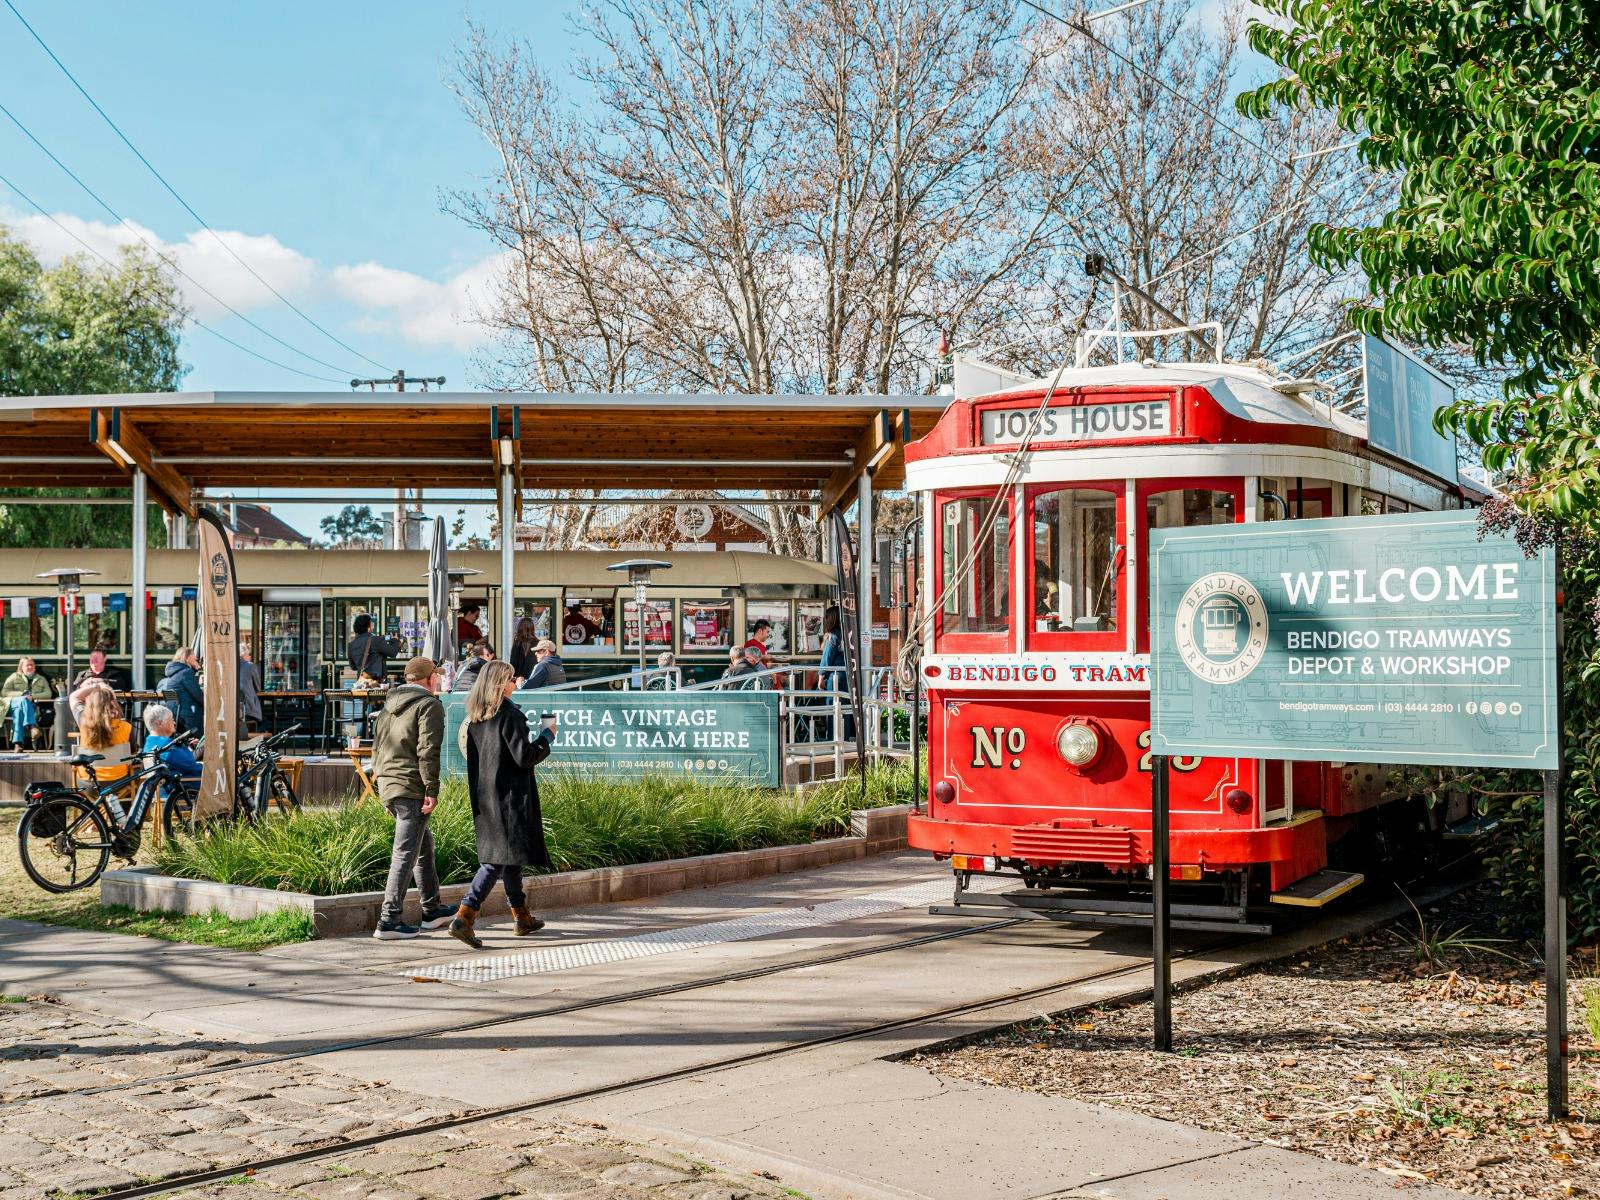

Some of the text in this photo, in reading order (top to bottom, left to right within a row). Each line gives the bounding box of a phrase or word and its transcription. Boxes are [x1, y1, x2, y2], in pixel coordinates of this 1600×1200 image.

[994, 403, 1165, 439] JOSS HOUSE
[1185, 577, 1256, 608] BENDIGO
[1281, 562, 1519, 605] WELCOME
[1287, 628, 1511, 649] BENDIGO TRAMWAYS
[1182, 638, 1262, 679] TRAMWAYS
[1288, 656, 1511, 676] DEPOT & WORKSHOP
[947, 663, 1150, 683] BENDIGO TRAM
[600, 709, 616, 726] A
[621, 709, 717, 726] VINTAGE
[1279, 701, 1453, 714] bendigotramways.com (03) 4444 2810
[528, 730, 750, 748] TLKING TRAM HERE
[536, 760, 674, 771] digotramways.com (03) 4444 2810
